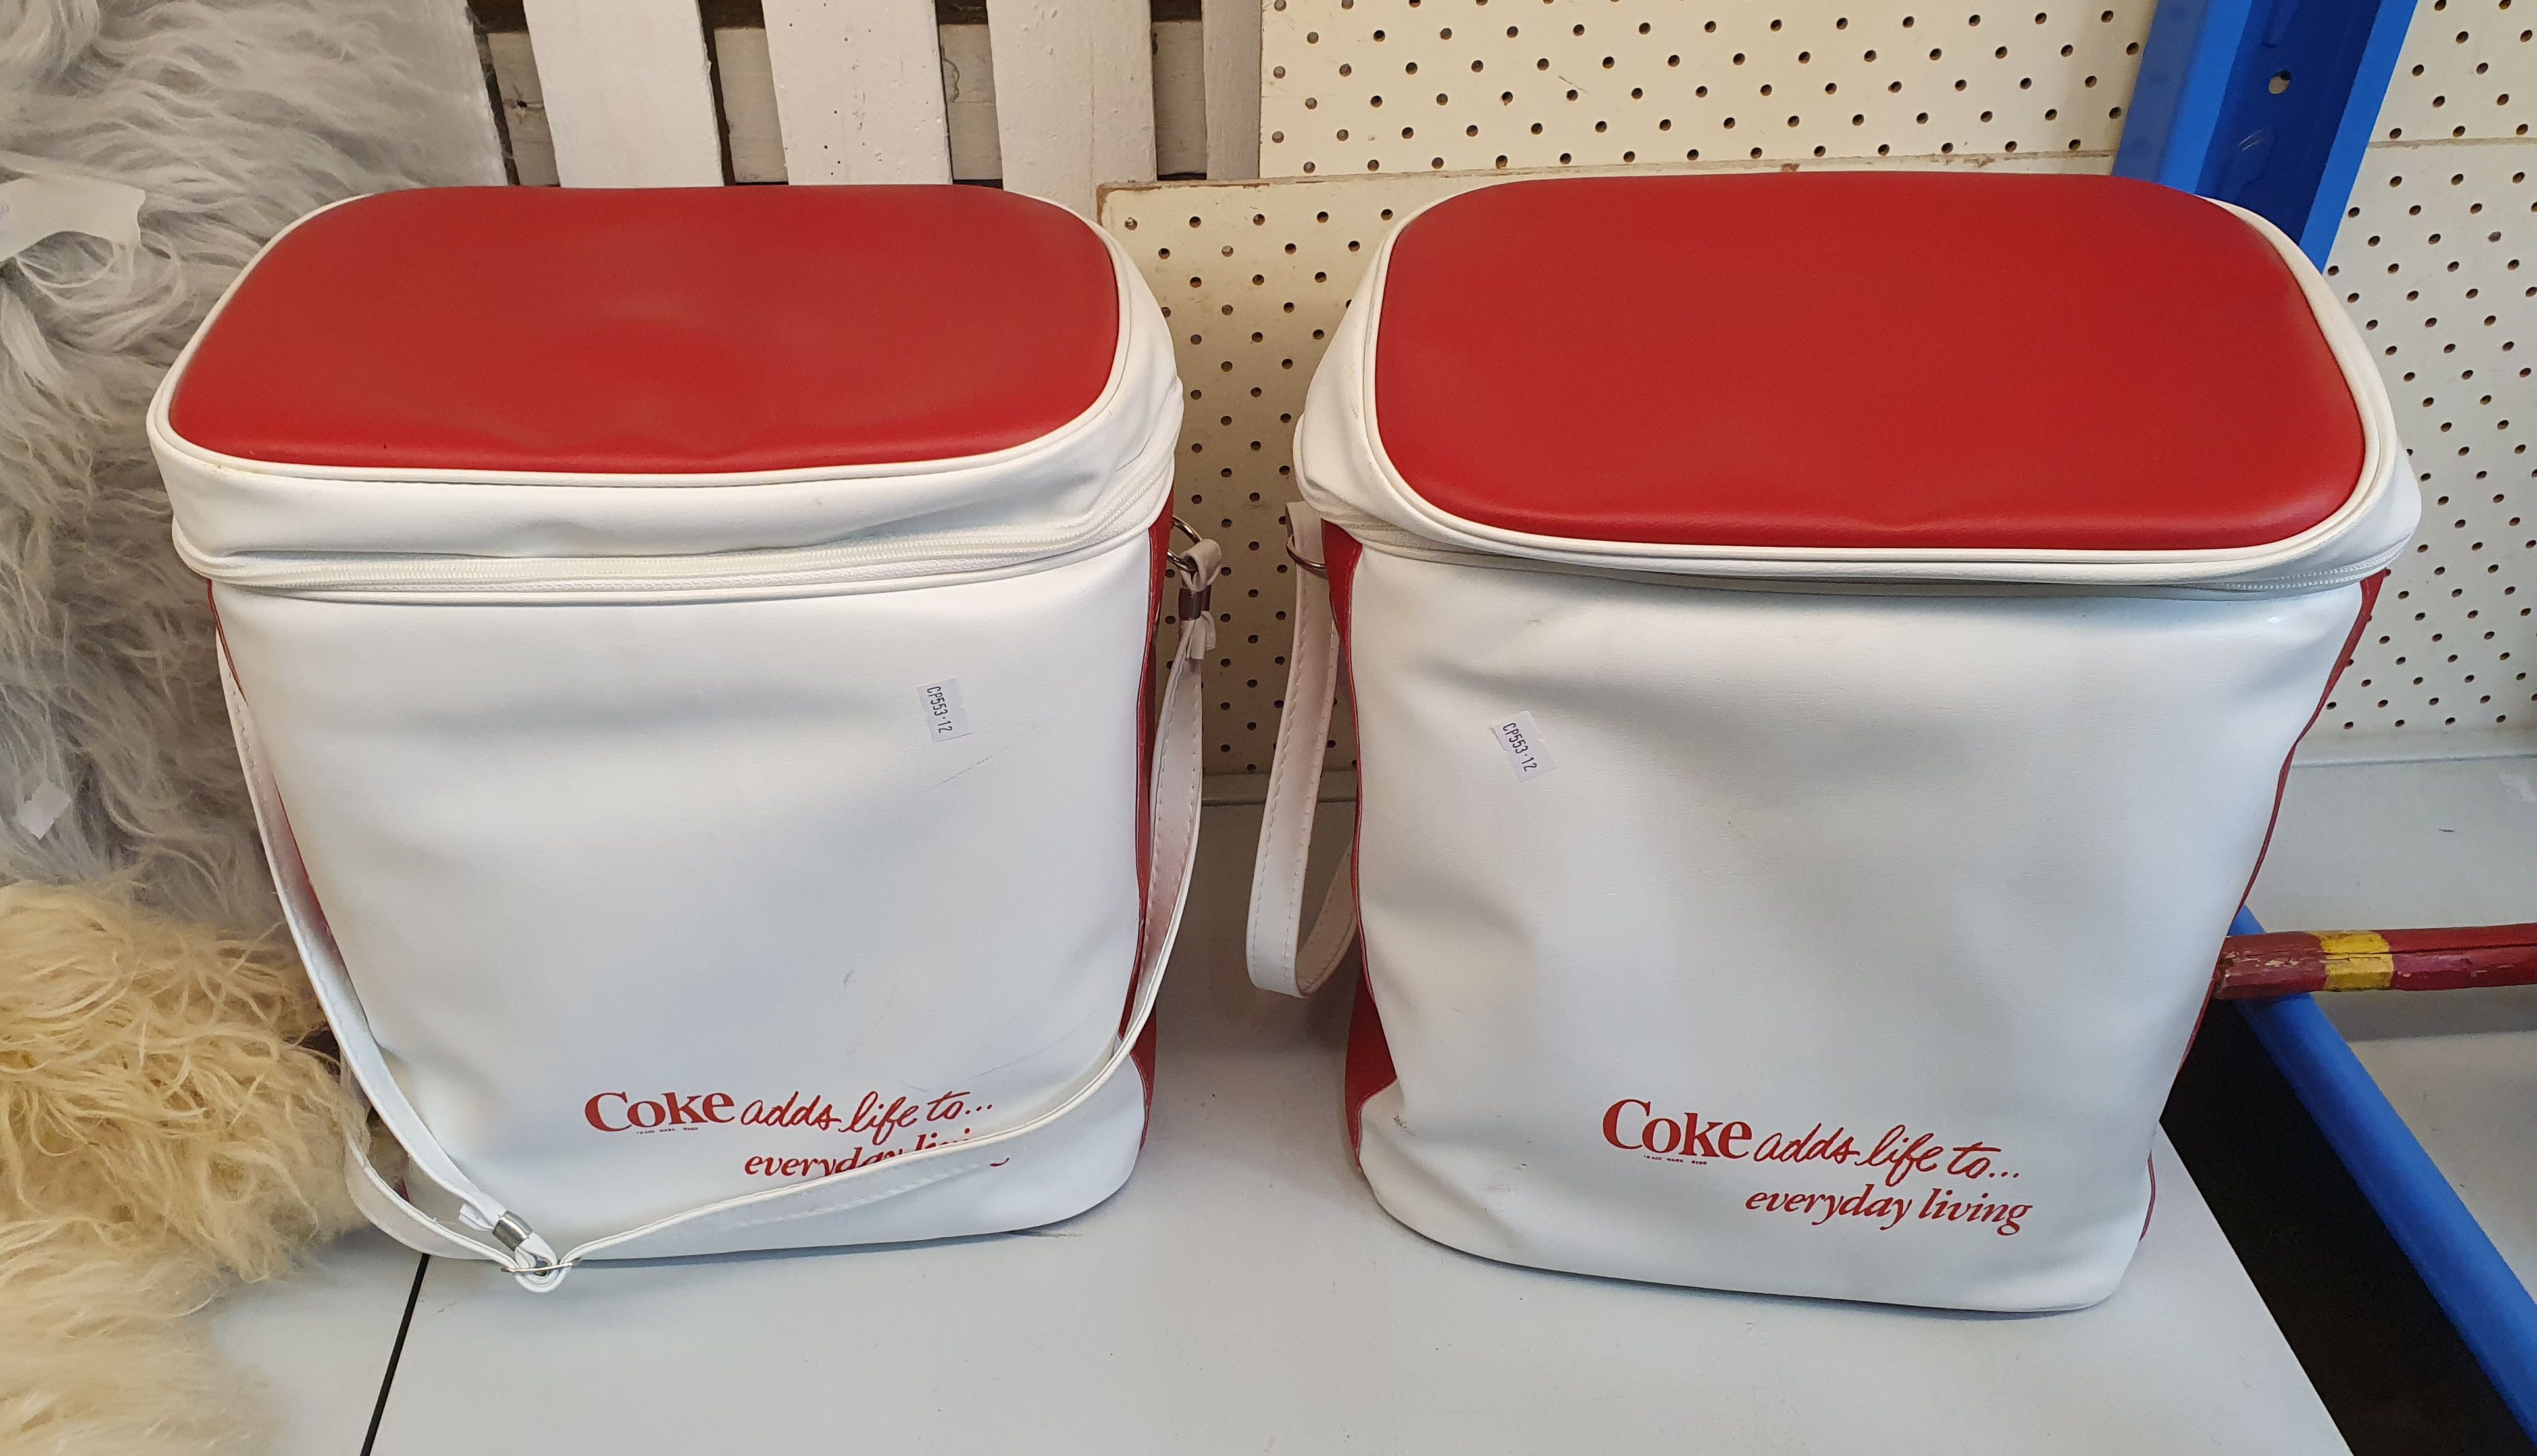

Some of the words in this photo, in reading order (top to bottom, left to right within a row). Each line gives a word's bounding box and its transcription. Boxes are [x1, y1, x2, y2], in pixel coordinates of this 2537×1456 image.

[584, 1092, 735, 1133] Coke
[740, 1091, 842, 1130] adds
[837, 1091, 919, 1145] life
[927, 1090, 994, 1121] to...
[1602, 1099, 1753, 1160] Coke
[1753, 1122, 1860, 1166] adds
[1857, 1124, 1943, 1188] life
[1947, 1141, 2020, 1180] to...
[1745, 1184, 1910, 1231] everyday
[1918, 1188, 2034, 1236] living
